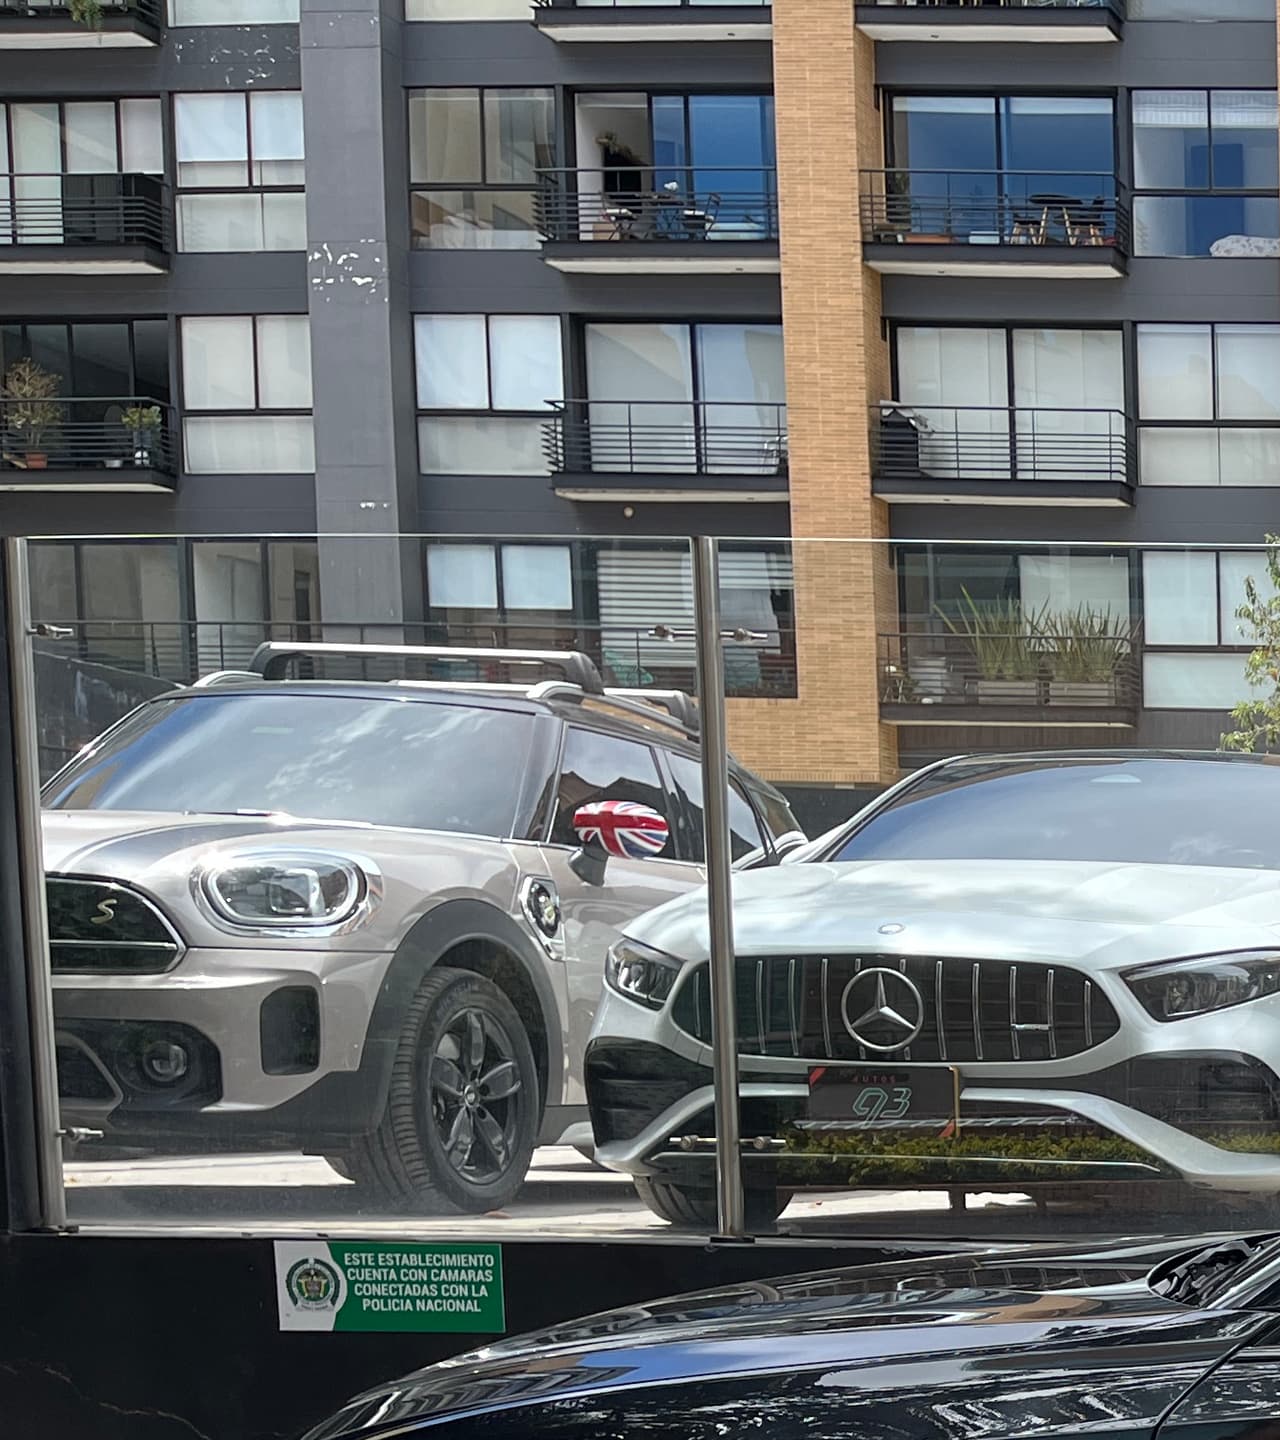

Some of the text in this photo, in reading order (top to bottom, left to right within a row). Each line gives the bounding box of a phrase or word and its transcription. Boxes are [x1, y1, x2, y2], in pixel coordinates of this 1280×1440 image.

[91, 898, 118, 924] S
[852, 1087, 912, 1130] 93
[344, 1253, 495, 1267] ESTE ESTABLECIMIENTO
[347, 1268, 494, 1283] CUENTA CON CAMARAS
[354, 1283, 488, 1297] CONECTADAS CON LA
[362, 1298, 482, 1313] POLICIA NACIONAL
